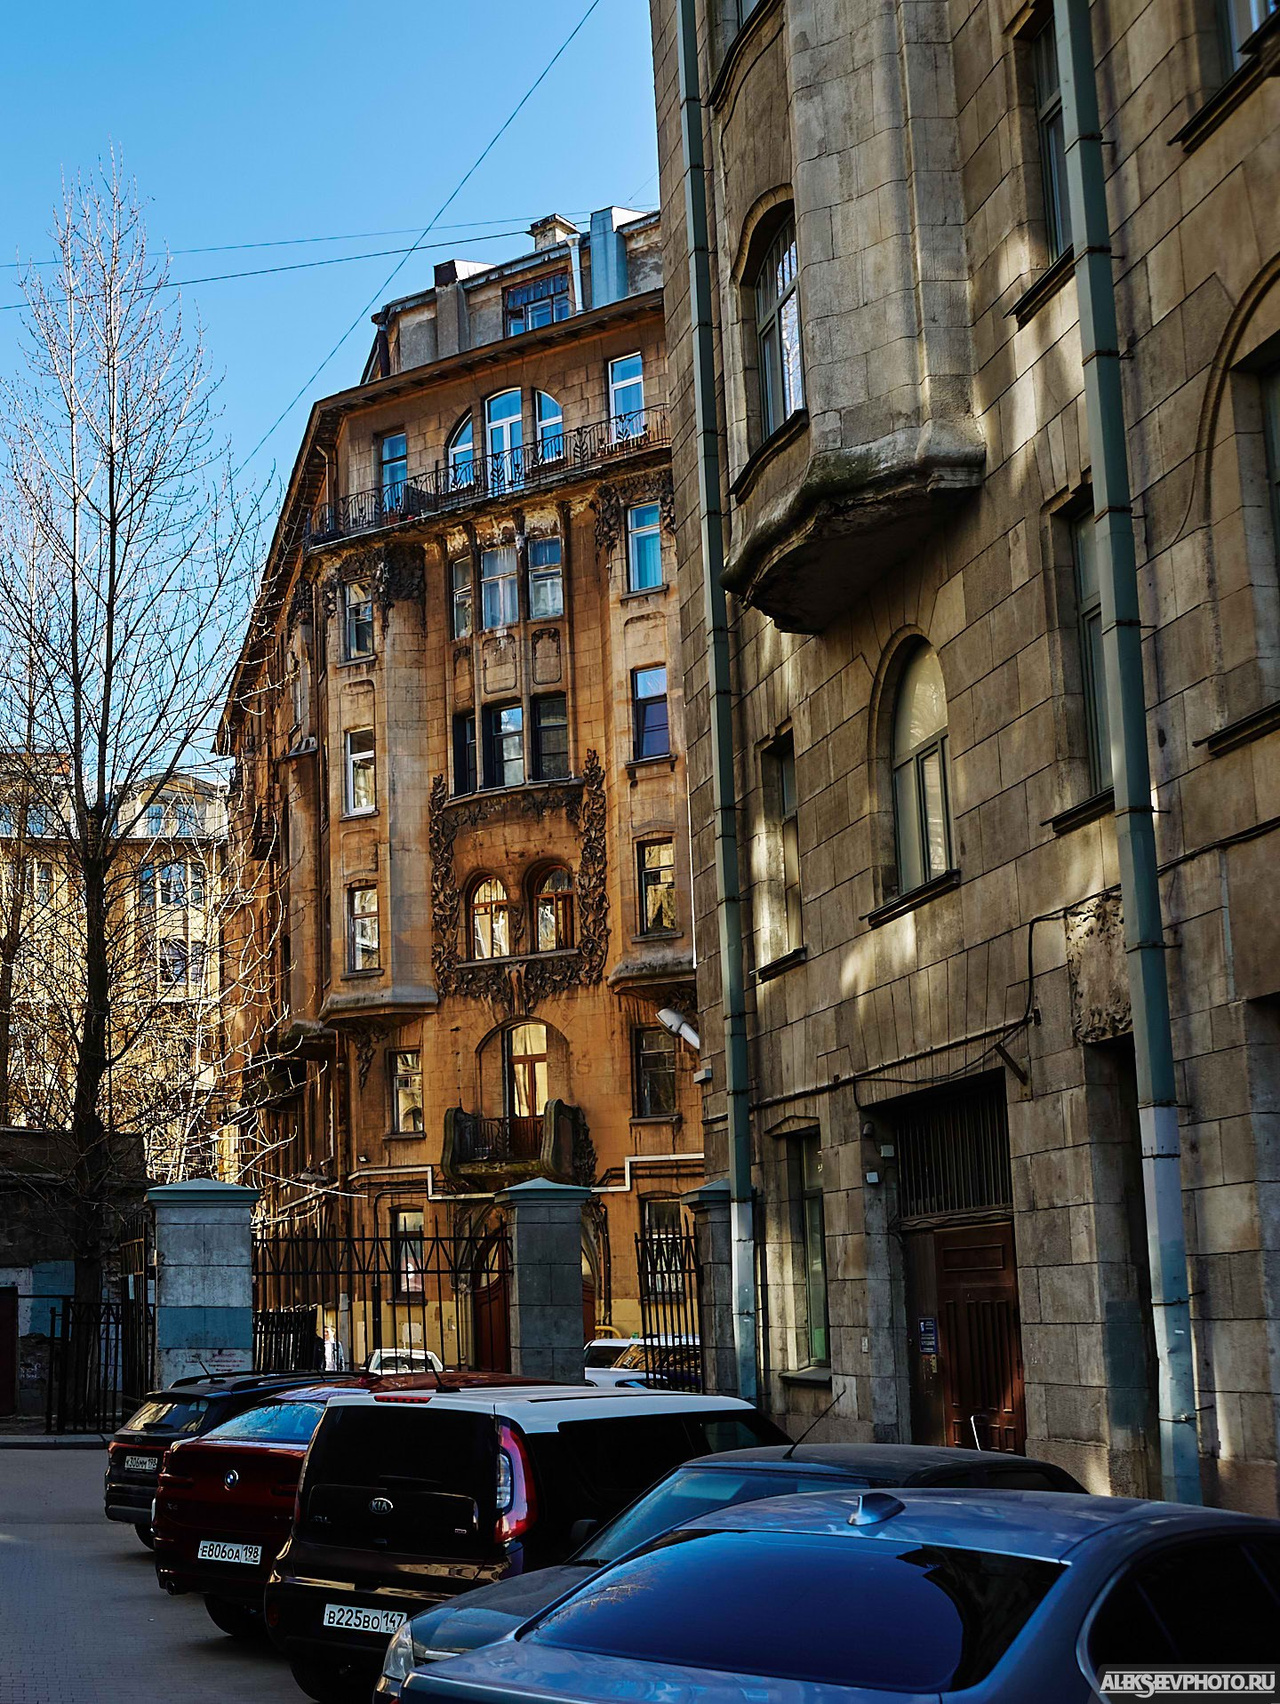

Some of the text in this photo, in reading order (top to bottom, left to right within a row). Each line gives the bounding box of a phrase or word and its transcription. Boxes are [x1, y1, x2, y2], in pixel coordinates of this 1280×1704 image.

[371, 1500, 388, 1511] KIA
[201, 1543, 259, 1560] Е806ОА 198
[327, 1607, 404, 1630] В225ВО 147
